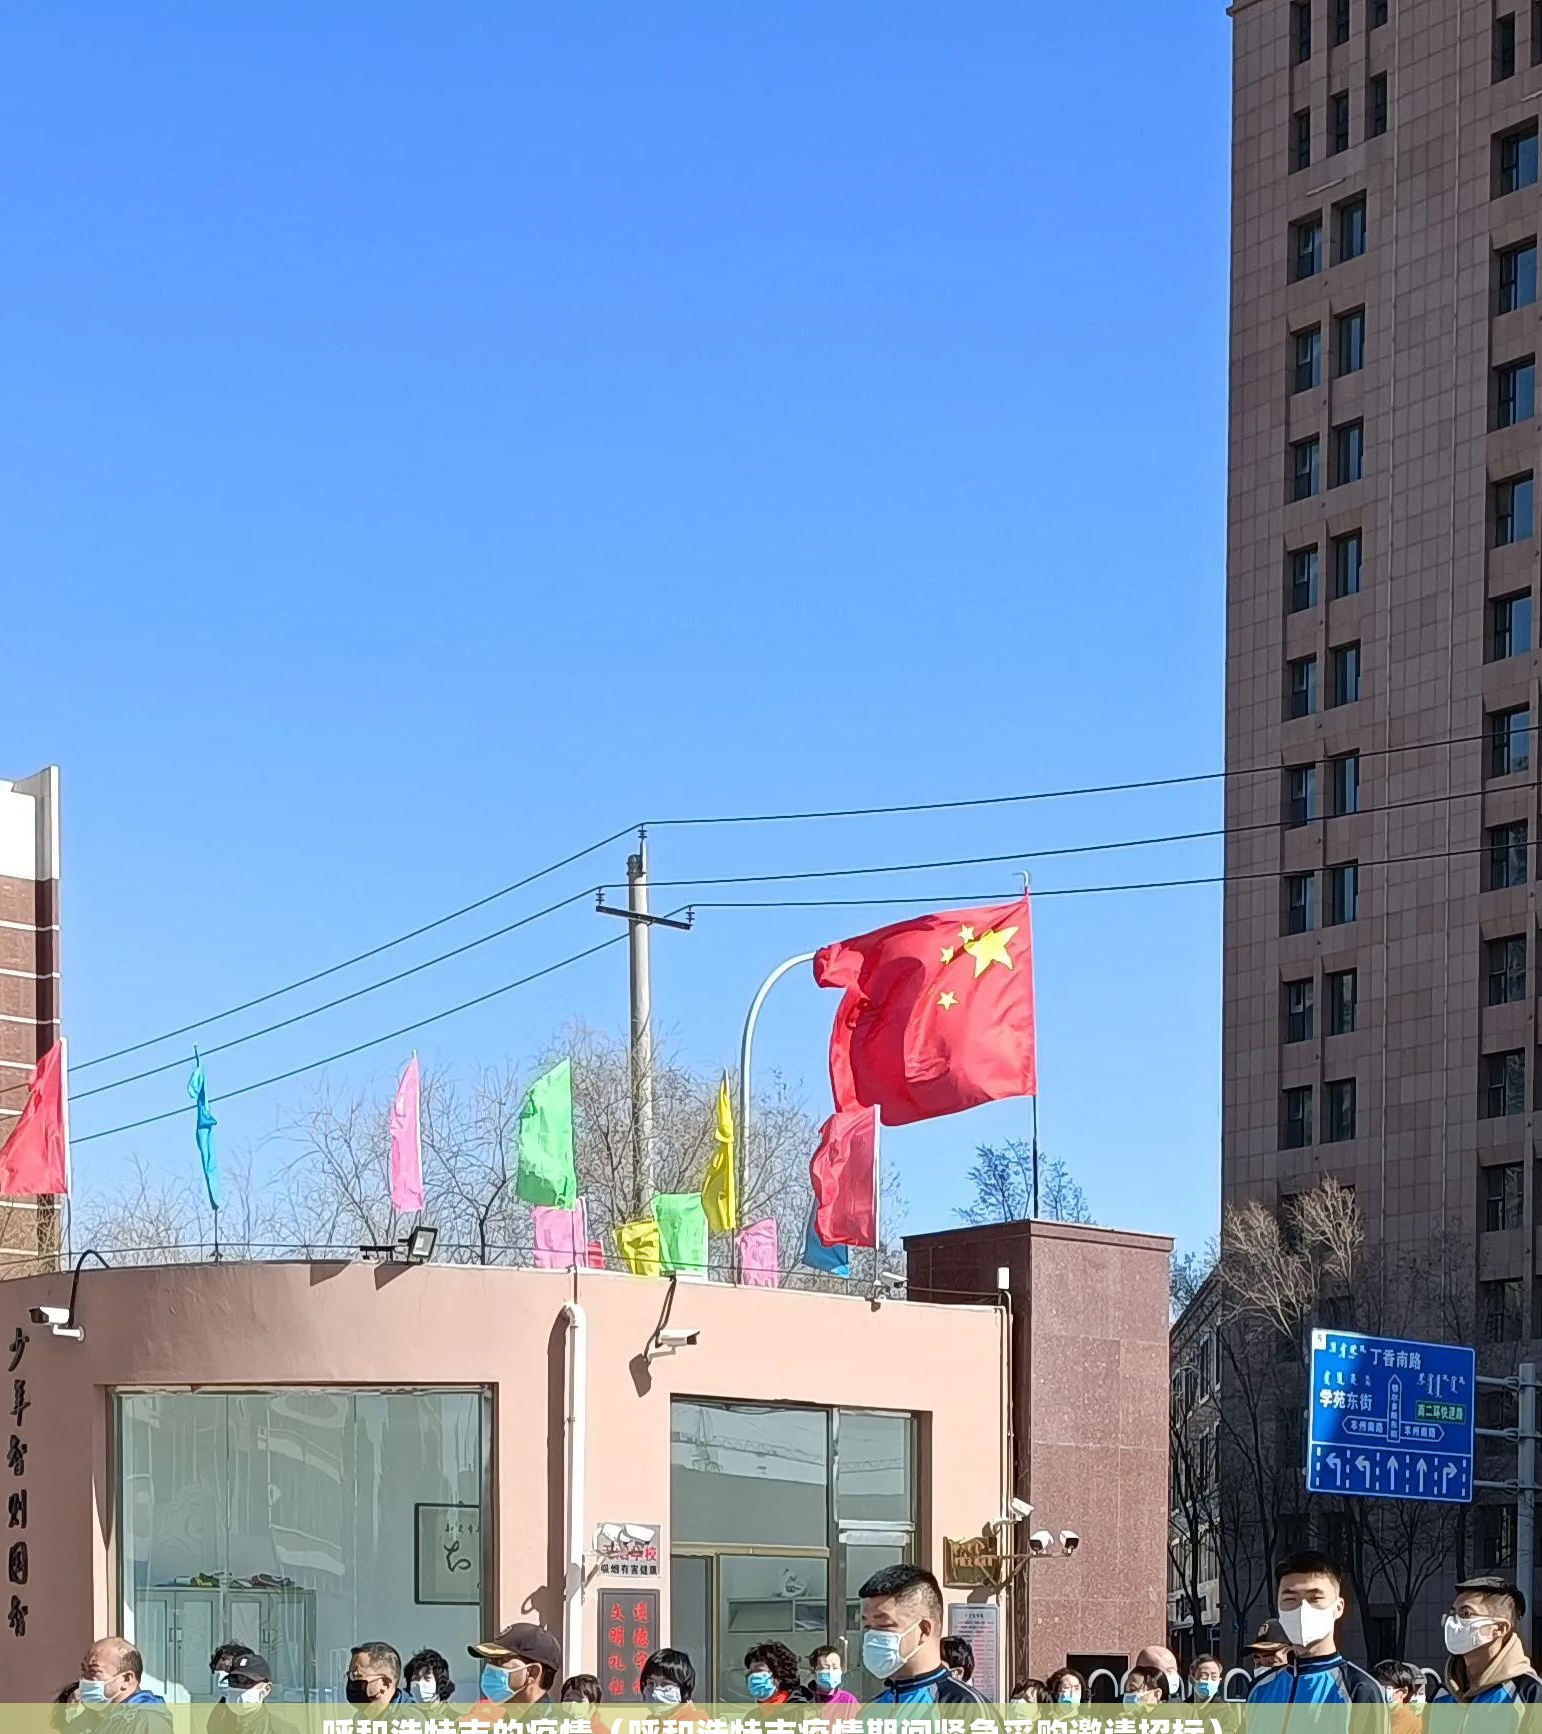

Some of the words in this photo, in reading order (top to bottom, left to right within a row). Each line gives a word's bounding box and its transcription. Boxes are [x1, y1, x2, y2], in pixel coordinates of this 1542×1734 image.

[1370, 1348, 1422, 1370] 丁香南路
[1319, 1389, 1373, 1411] 学苑东街
